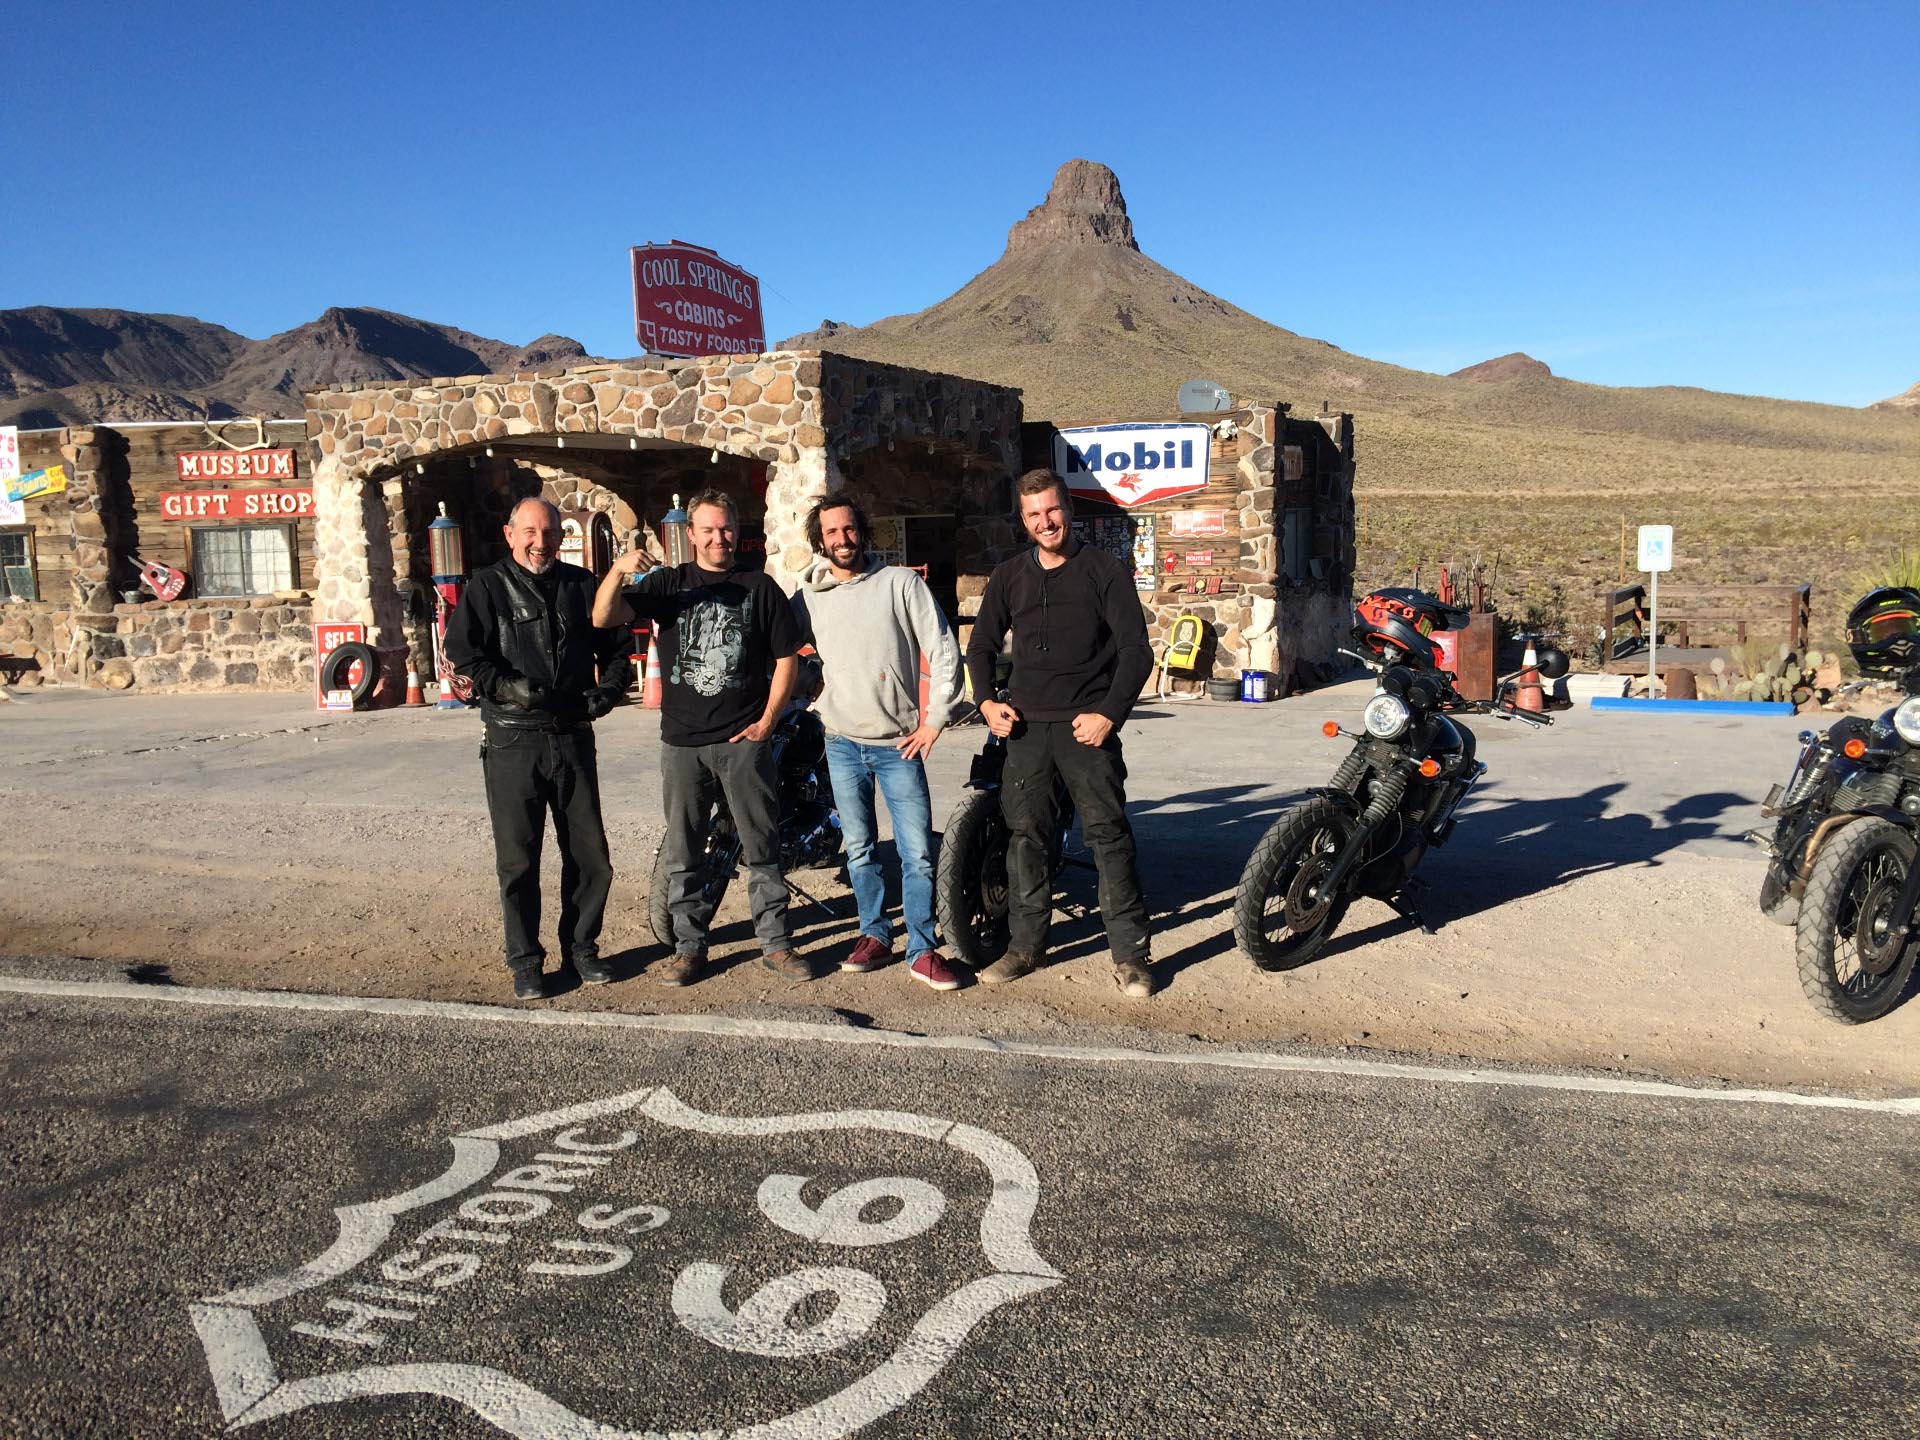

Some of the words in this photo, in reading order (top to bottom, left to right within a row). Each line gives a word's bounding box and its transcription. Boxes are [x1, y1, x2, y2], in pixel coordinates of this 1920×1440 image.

[642, 258, 686, 289] COOL
[687, 260, 753, 310] SPRINGS
[674, 300, 726, 329] CABINS
[660, 326, 702, 348] TASTY
[707, 334, 747, 355] FOODS
[180, 453, 290, 476] MUSEUM
[1066, 439, 1193, 473] Mobil
[164, 494, 229, 515] GIFT
[245, 492, 312, 514] SHOP
[290, 1127, 639, 1348] HISTORIC
[527, 1203, 671, 1277] US
[671, 1174, 949, 1358] 66
